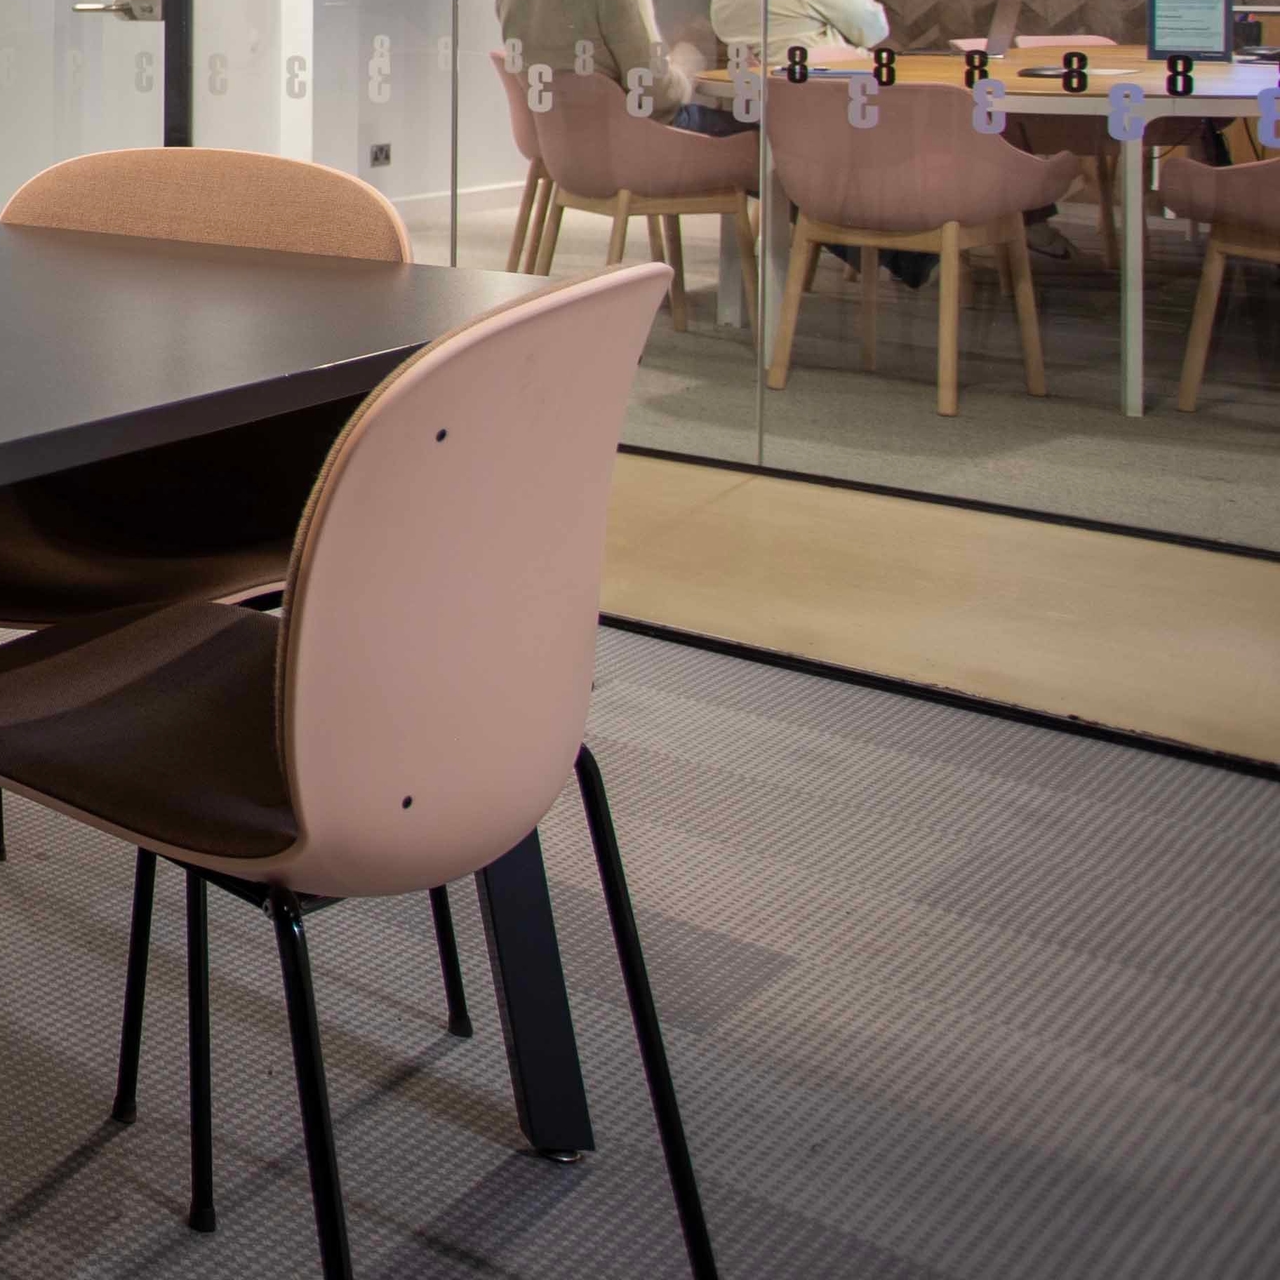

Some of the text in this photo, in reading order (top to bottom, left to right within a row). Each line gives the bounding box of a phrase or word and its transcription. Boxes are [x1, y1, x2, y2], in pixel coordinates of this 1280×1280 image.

[504, 38, 523, 73] 8
[575, 40, 594, 75] 8
[787, 46, 808, 83] 8
[873, 48, 896, 86] 8
[1062, 52, 1088, 93] 8
[1166, 55, 1193, 96] 8
